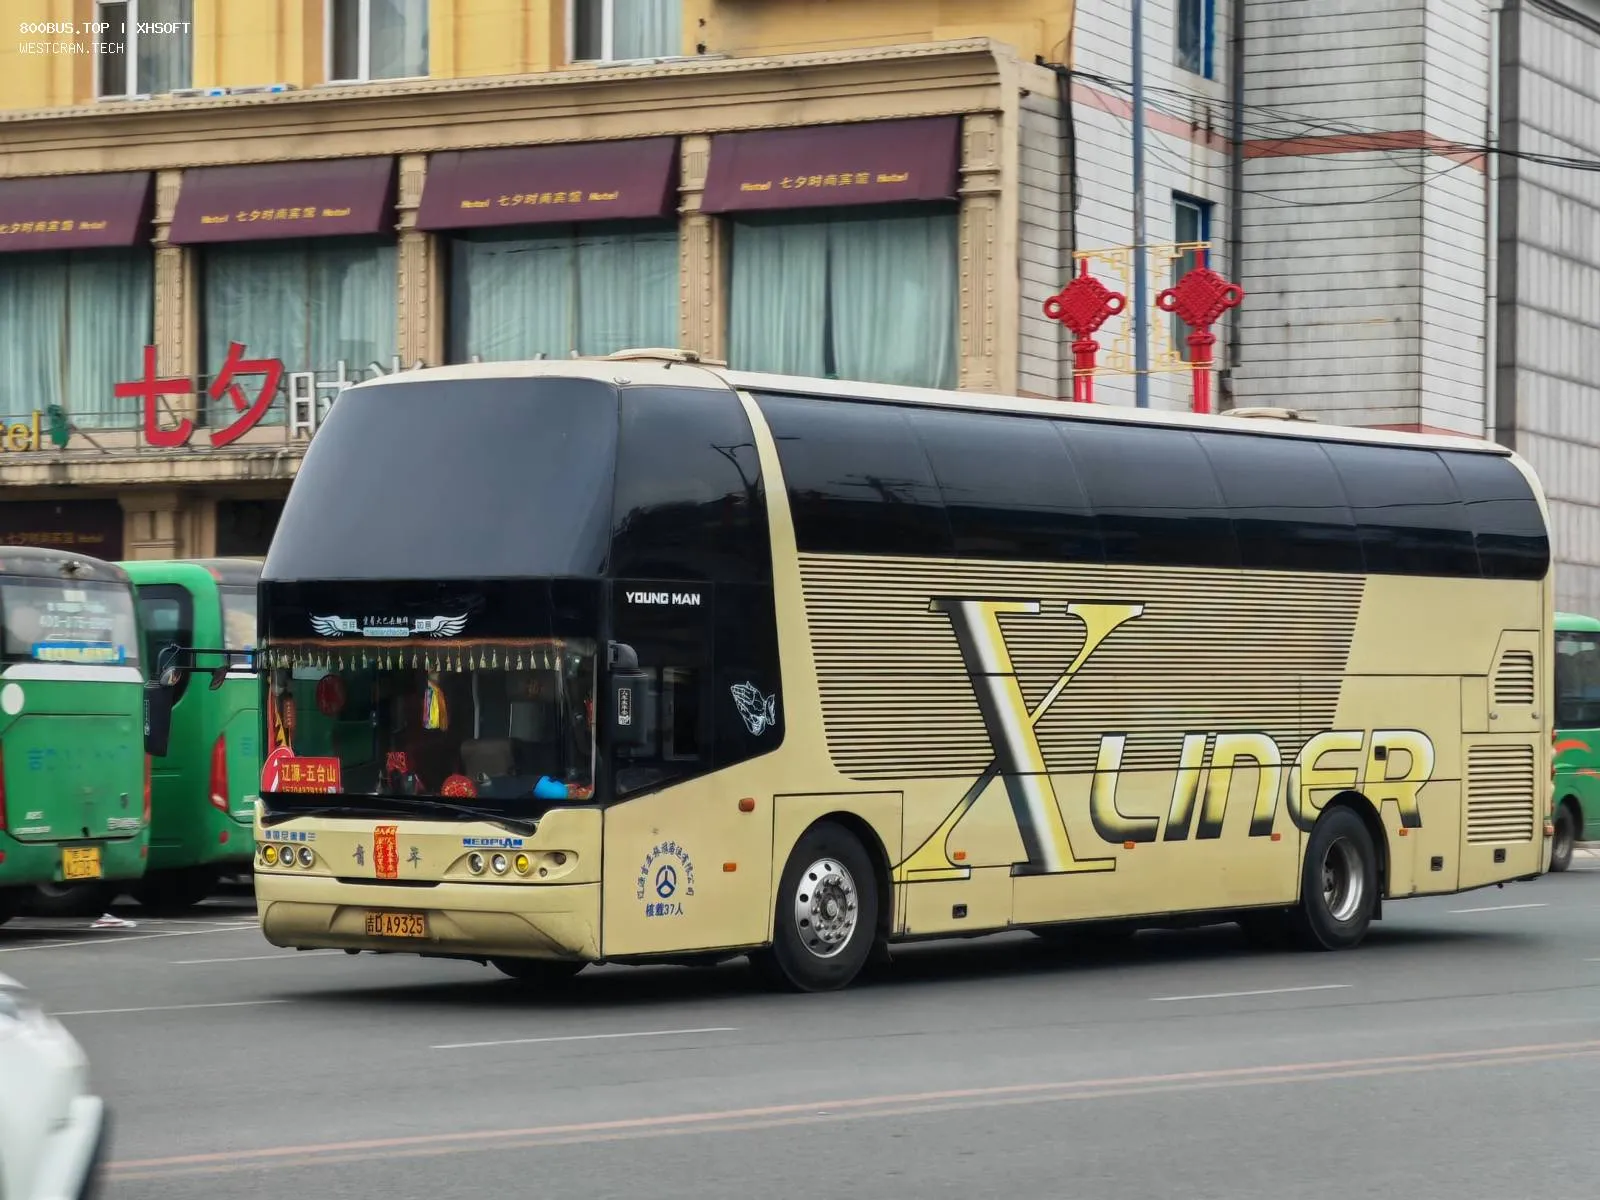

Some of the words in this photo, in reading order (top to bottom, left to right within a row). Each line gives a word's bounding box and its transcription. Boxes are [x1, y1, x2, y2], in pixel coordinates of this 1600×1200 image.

[626, 592, 669, 604] YOUNG
[672, 593, 700, 605] MAN
[281, 764, 336, 783] 辽源-五台山
[463, 837, 523, 848] NEOPLAN
